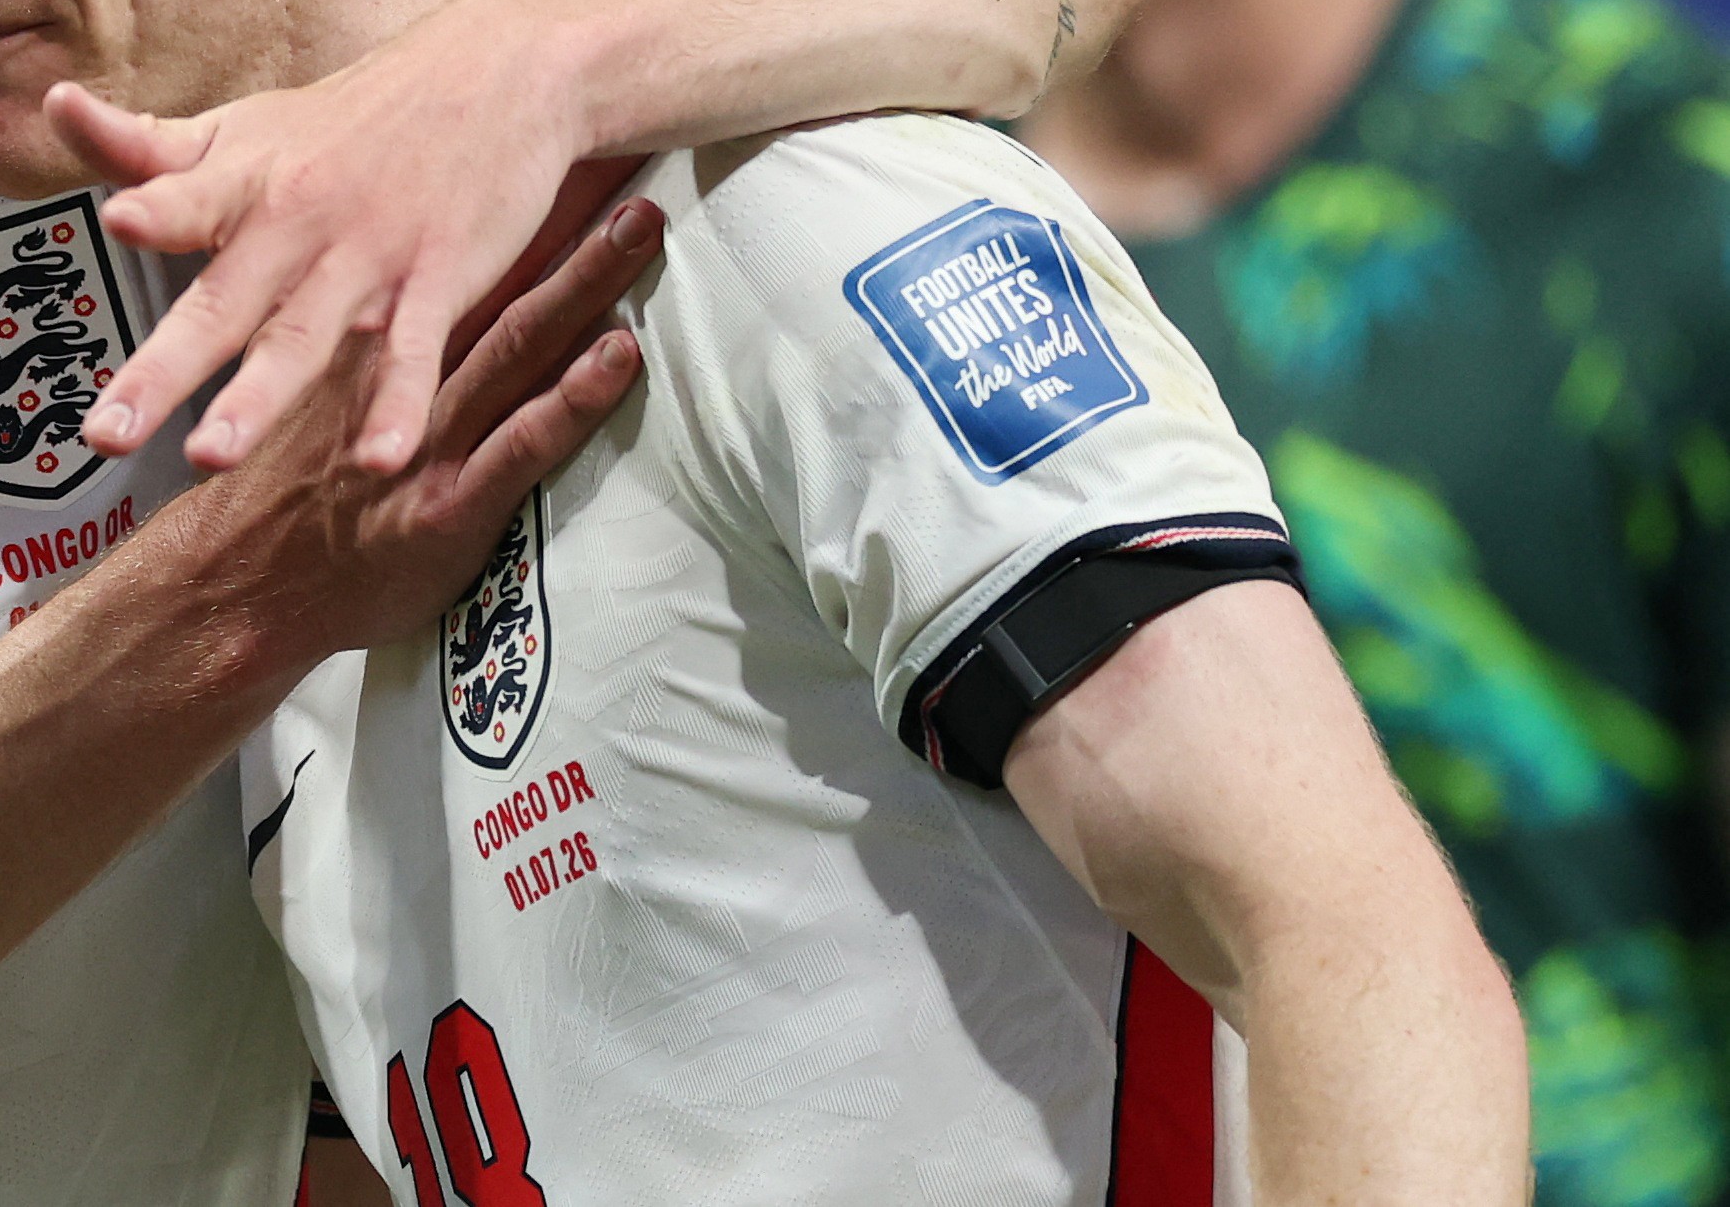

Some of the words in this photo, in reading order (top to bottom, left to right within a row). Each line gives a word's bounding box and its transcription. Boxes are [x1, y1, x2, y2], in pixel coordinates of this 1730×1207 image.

[900, 232, 1030, 318] FOOTBALL
[925, 269, 1054, 361] UNITES
[955, 359, 1013, 409] the
[1000, 314, 1087, 378] World
[1019, 376, 1074, 411] FIFA
[105, 495, 135, 547] DR
[474, 782, 547, 860] CONGO
[546, 760, 596, 813] DR
[504, 831, 597, 912] 01.07.26
